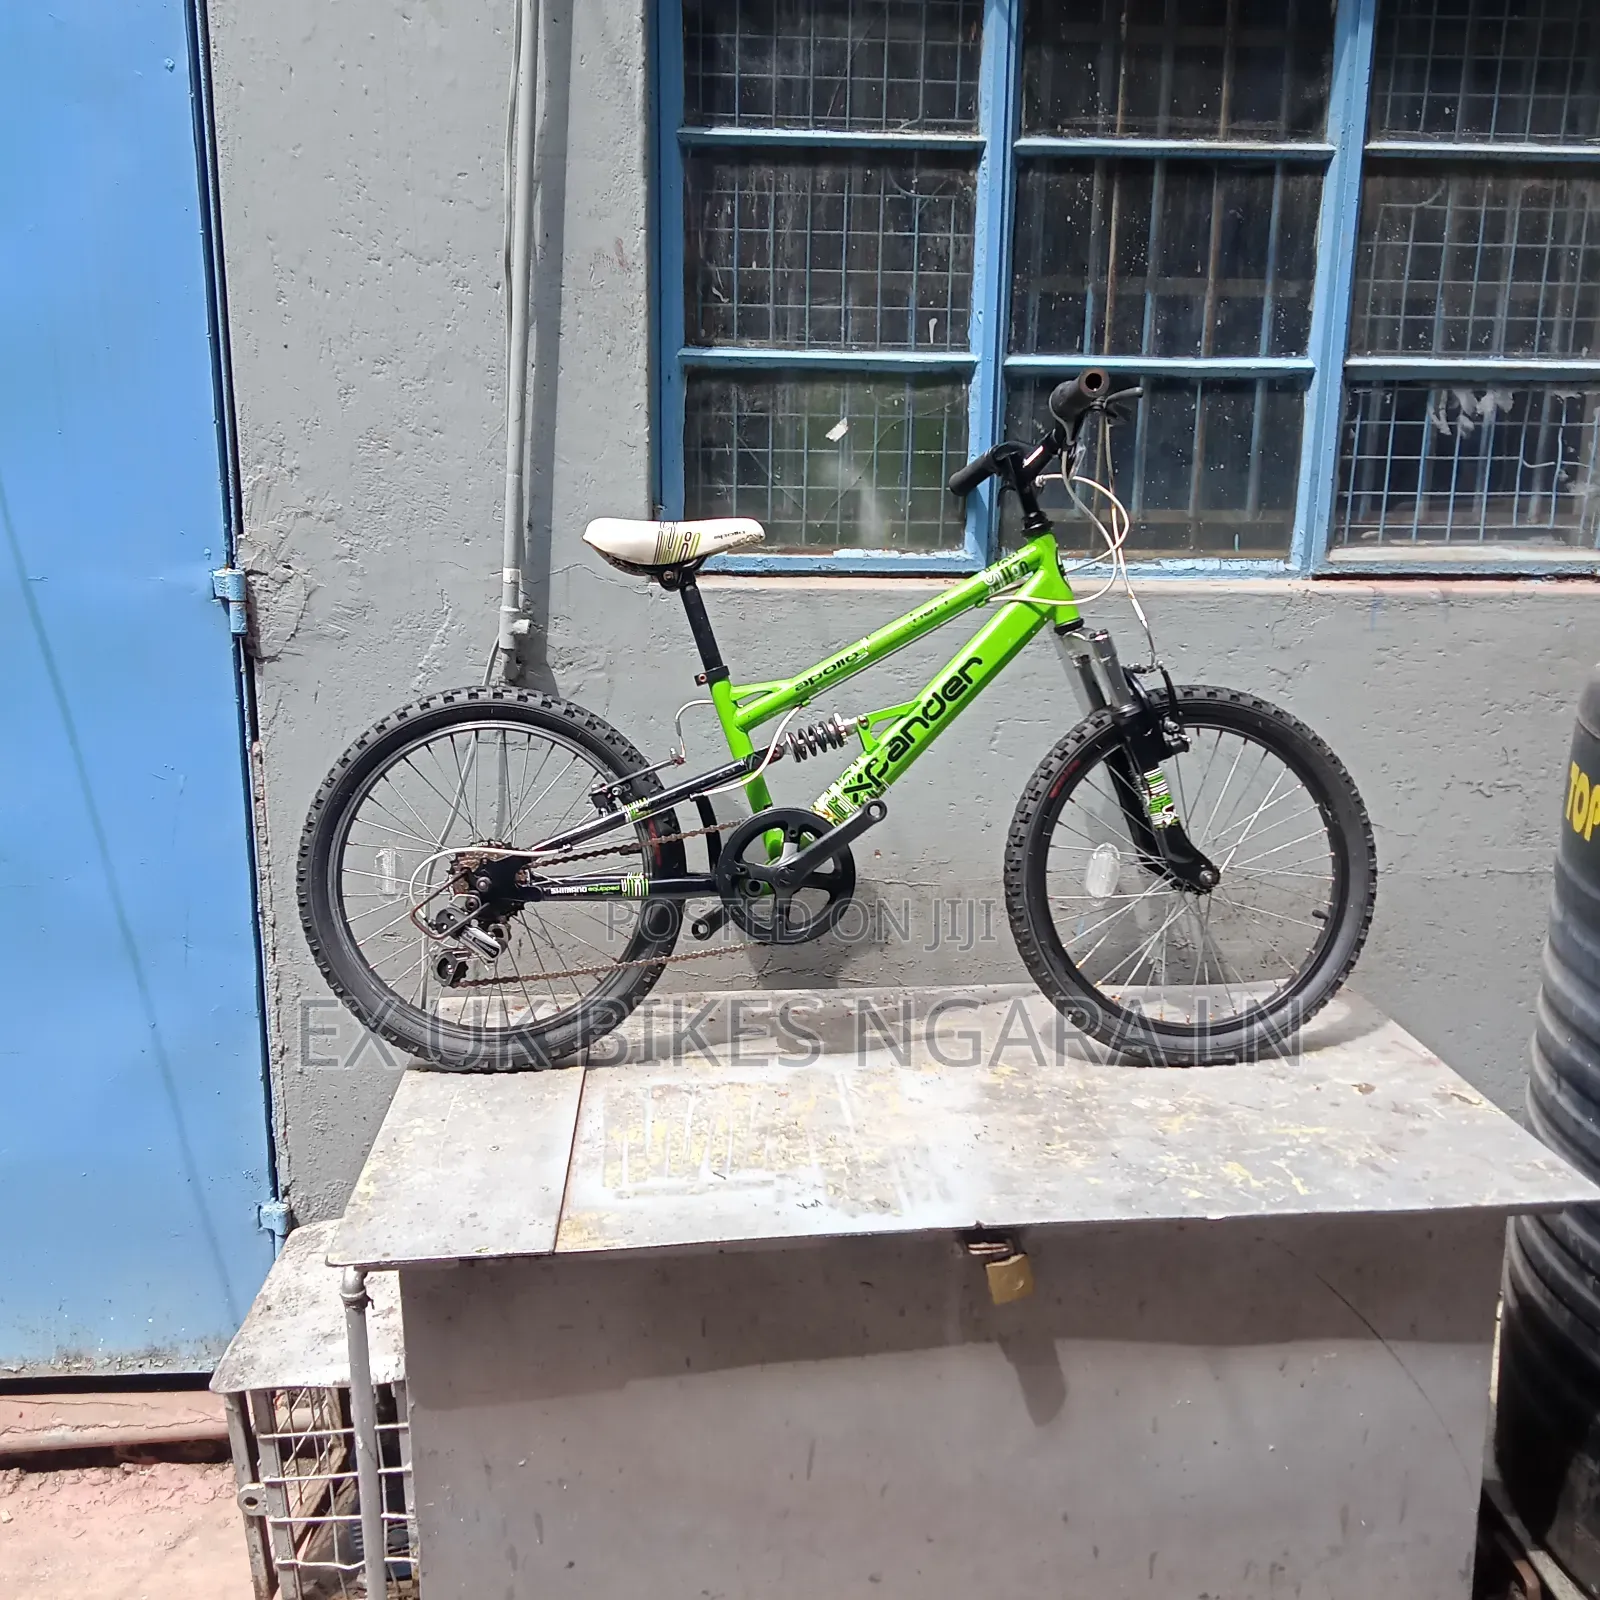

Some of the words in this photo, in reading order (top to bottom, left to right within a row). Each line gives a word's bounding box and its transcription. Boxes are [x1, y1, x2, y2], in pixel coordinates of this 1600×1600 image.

[794, 651, 859, 692] apollo
[550, 885, 588, 895] SHIMANO
[587, 884, 621, 894] equipped
